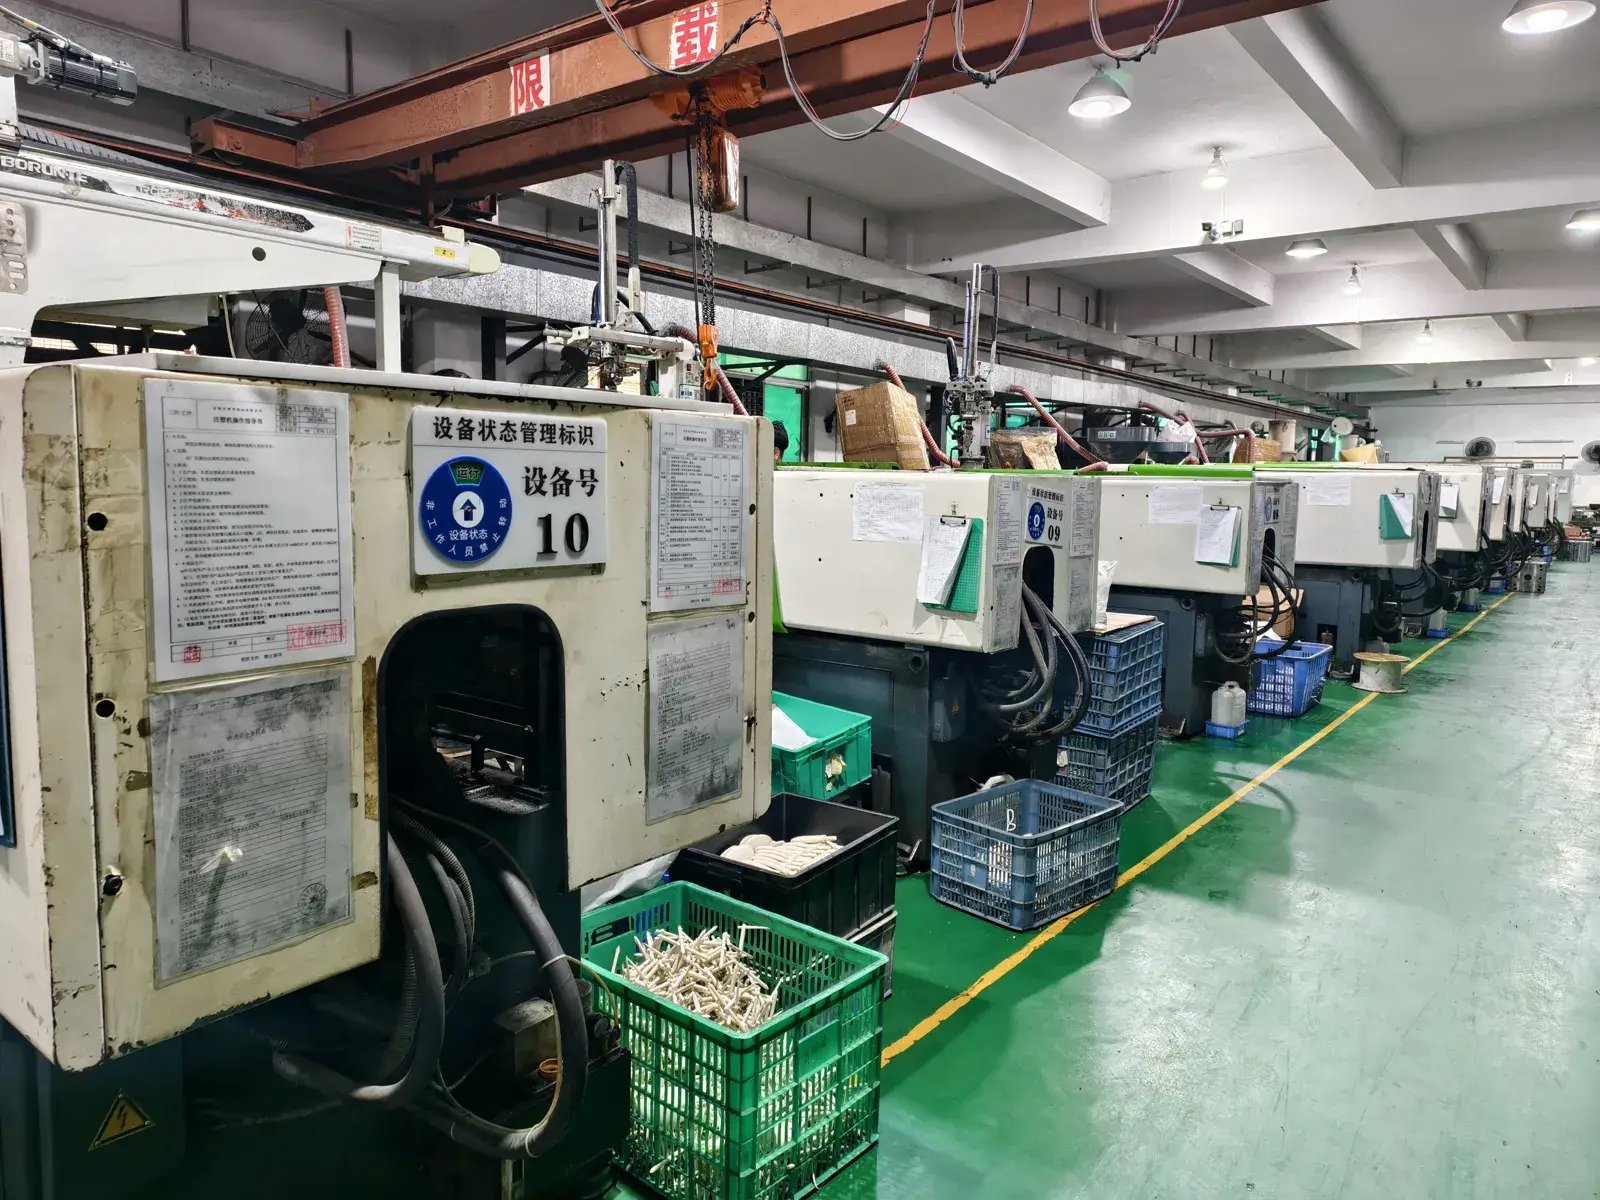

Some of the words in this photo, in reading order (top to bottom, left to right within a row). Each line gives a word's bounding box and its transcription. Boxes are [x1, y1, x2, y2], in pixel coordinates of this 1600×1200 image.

[513, 57, 545, 116] 限
[675, 2, 719, 67] 载
[1, 155, 89, 184] BORUNTE
[432, 415, 595, 447] 设备状态管理标识
[456, 465, 481, 480] 运行
[522, 465, 599, 498] 设备号
[1047, 507, 1064, 521] 设备号
[449, 528, 489, 541] 设备状态
[537, 512, 590, 556] 10
[1048, 525, 1061, 542] 09
